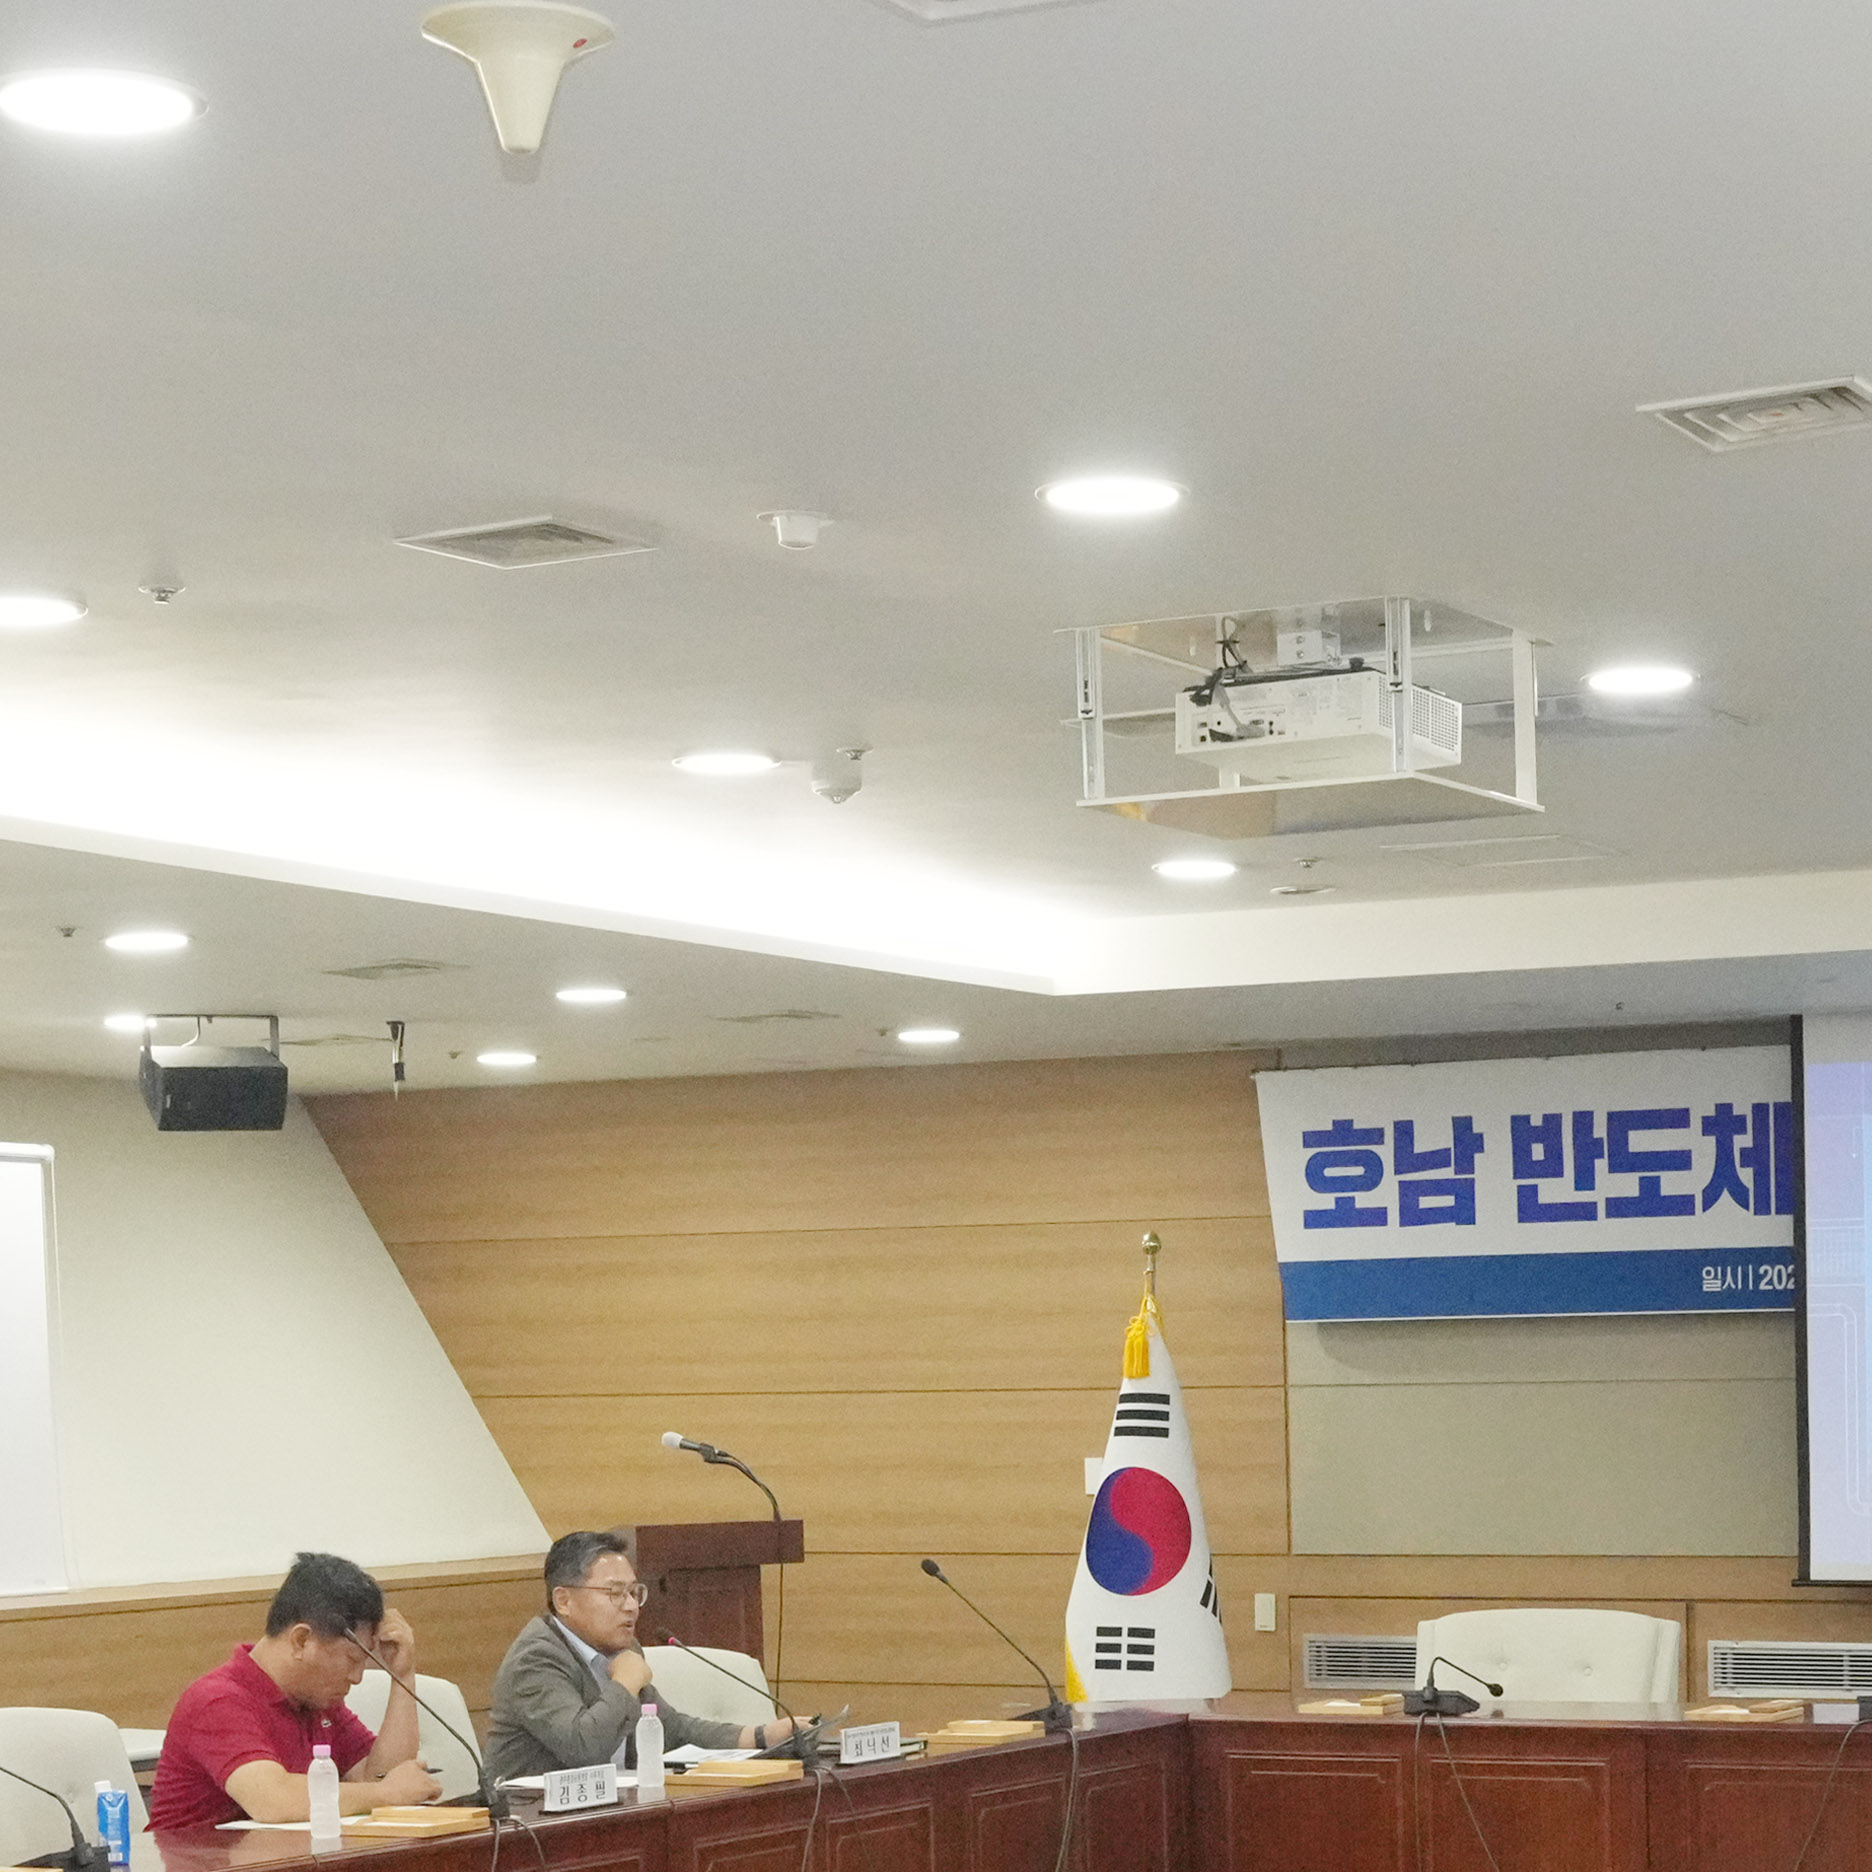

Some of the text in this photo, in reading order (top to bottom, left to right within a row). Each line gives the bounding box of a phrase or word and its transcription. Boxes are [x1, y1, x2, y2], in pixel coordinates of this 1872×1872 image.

[1302, 1115, 1484, 1230] 호남
[1510, 1101, 1793, 1224] 반도체
[1702, 1266, 1742, 1292] 일시
[560, 1780, 606, 1805] 김종필
